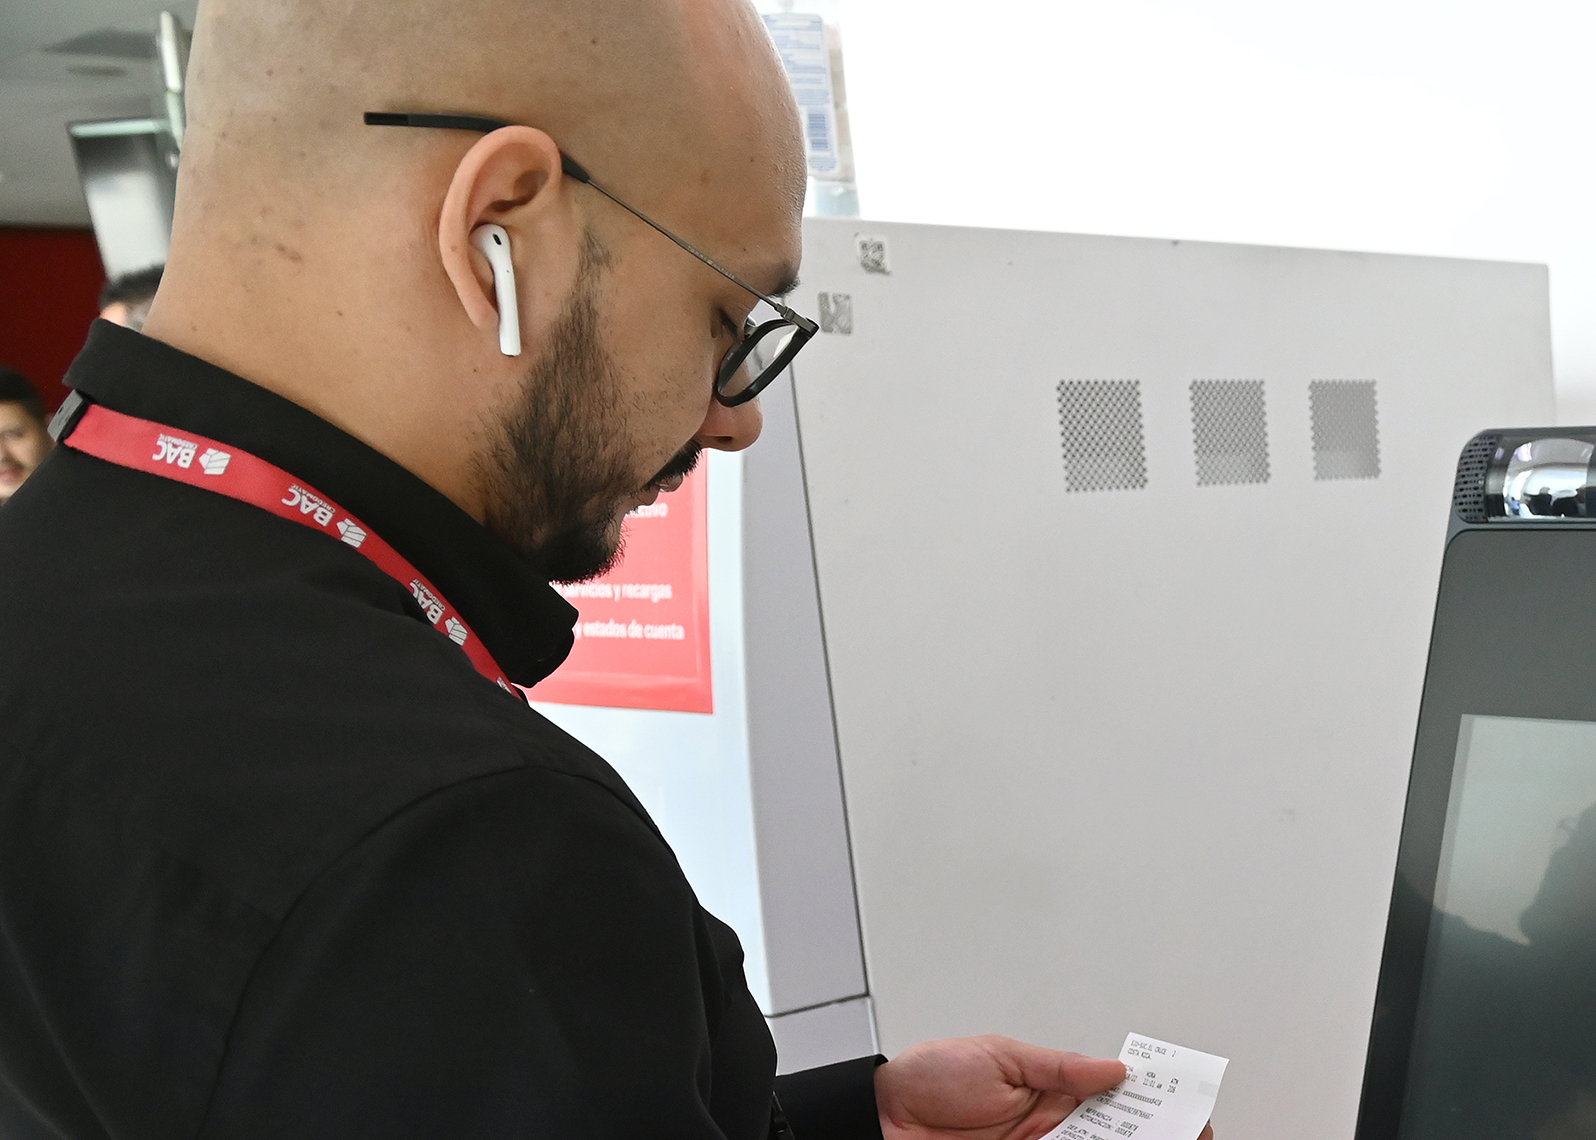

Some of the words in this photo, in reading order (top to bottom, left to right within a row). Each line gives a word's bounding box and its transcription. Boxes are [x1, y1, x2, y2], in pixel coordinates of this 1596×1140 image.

[152, 440, 197, 469] BAC
[281, 488, 333, 526] BAC
[613, 584, 621, 602] y
[621, 583, 673, 603] recargas
[582, 618, 627, 638] estados
[627, 618, 644, 639] de
[643, 622, 685, 641] cuenta
